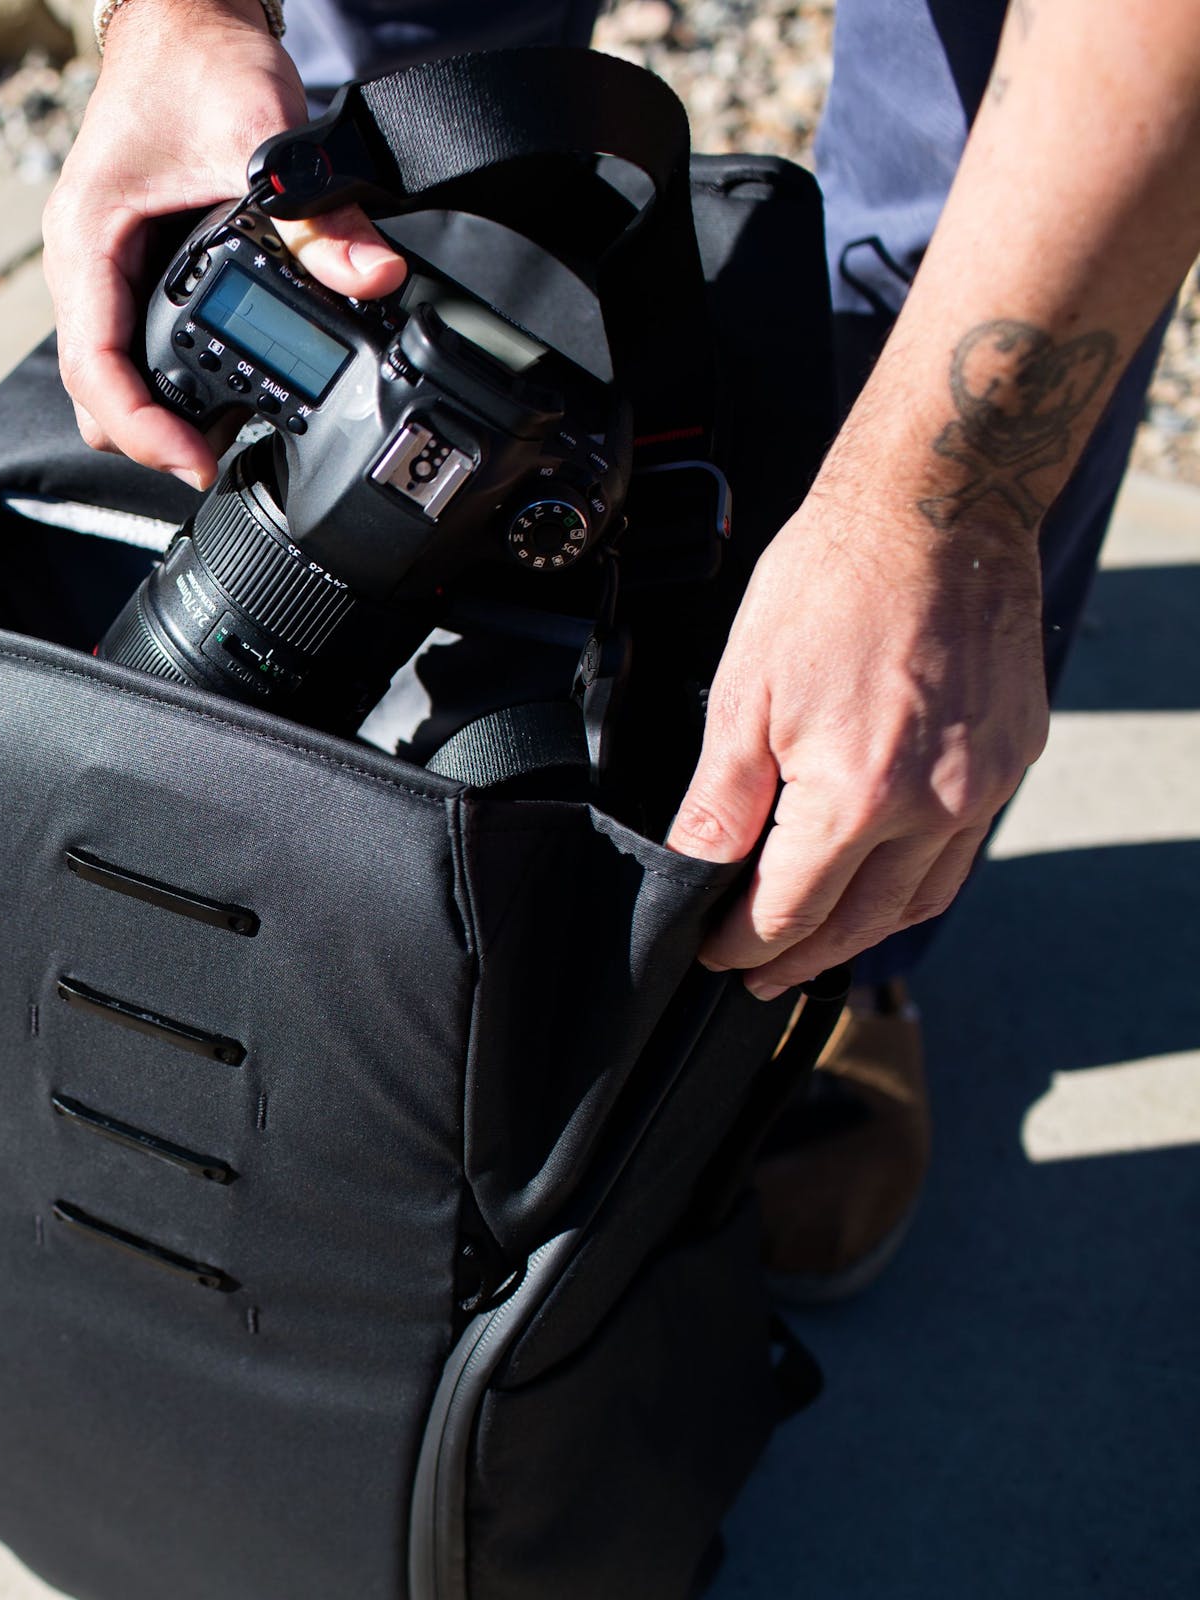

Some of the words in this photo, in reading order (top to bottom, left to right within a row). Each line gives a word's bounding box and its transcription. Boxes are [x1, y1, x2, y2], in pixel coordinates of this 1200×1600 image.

[237, 360, 254, 377] ISO
[261, 377, 289, 402] DRIVE
[297, 405, 312, 417] AF
[553, 505, 562, 514] P
[591, 498, 605, 513] OFF
[513, 534, 524, 542] M
[288, 544, 302, 557] 35
[562, 542, 580, 556] SCN
[186, 569, 217, 614] ULTRASONIC
[333, 579, 349, 590] 24
[176, 574, 210, 628] 24-70mm
